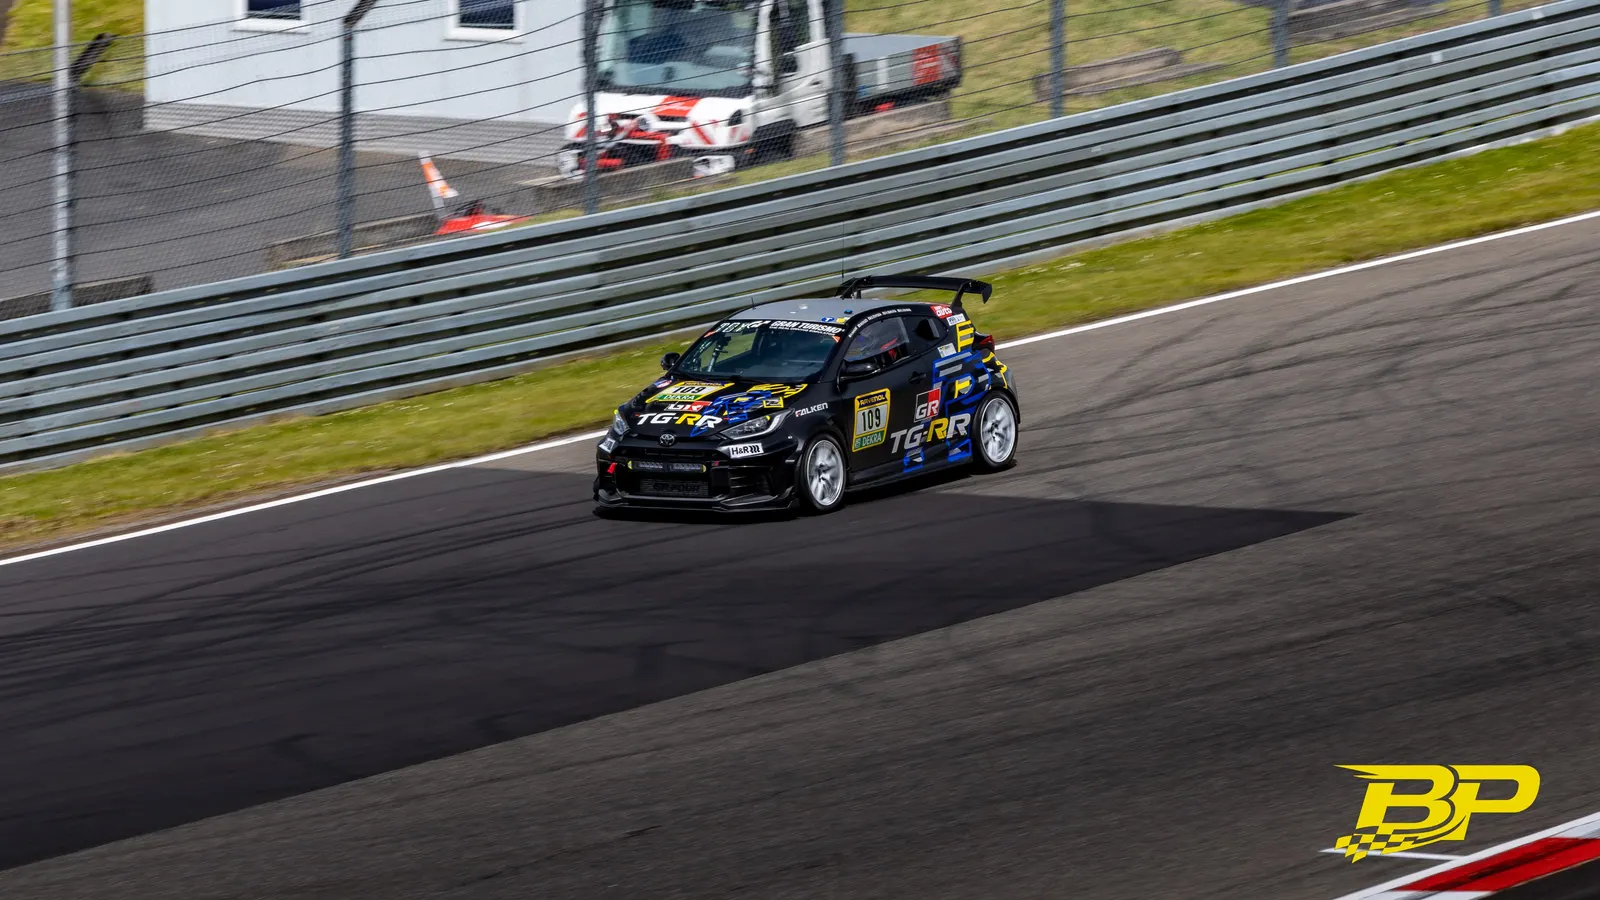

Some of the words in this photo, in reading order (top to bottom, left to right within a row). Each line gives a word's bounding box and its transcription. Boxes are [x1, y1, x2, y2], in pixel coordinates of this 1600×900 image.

[770, 320, 800, 328] GRAN
[799, 322, 842, 334] TURISMO
[672, 386, 706, 394] 109
[860, 394, 886, 406] RAVENOL
[795, 402, 828, 417] FALKEN
[915, 399, 940, 420] GR
[637, 412, 723, 428] TG-RR
[861, 407, 881, 432] 109
[862, 432, 882, 446] DEKRA
[731, 445, 750, 455] H&R
